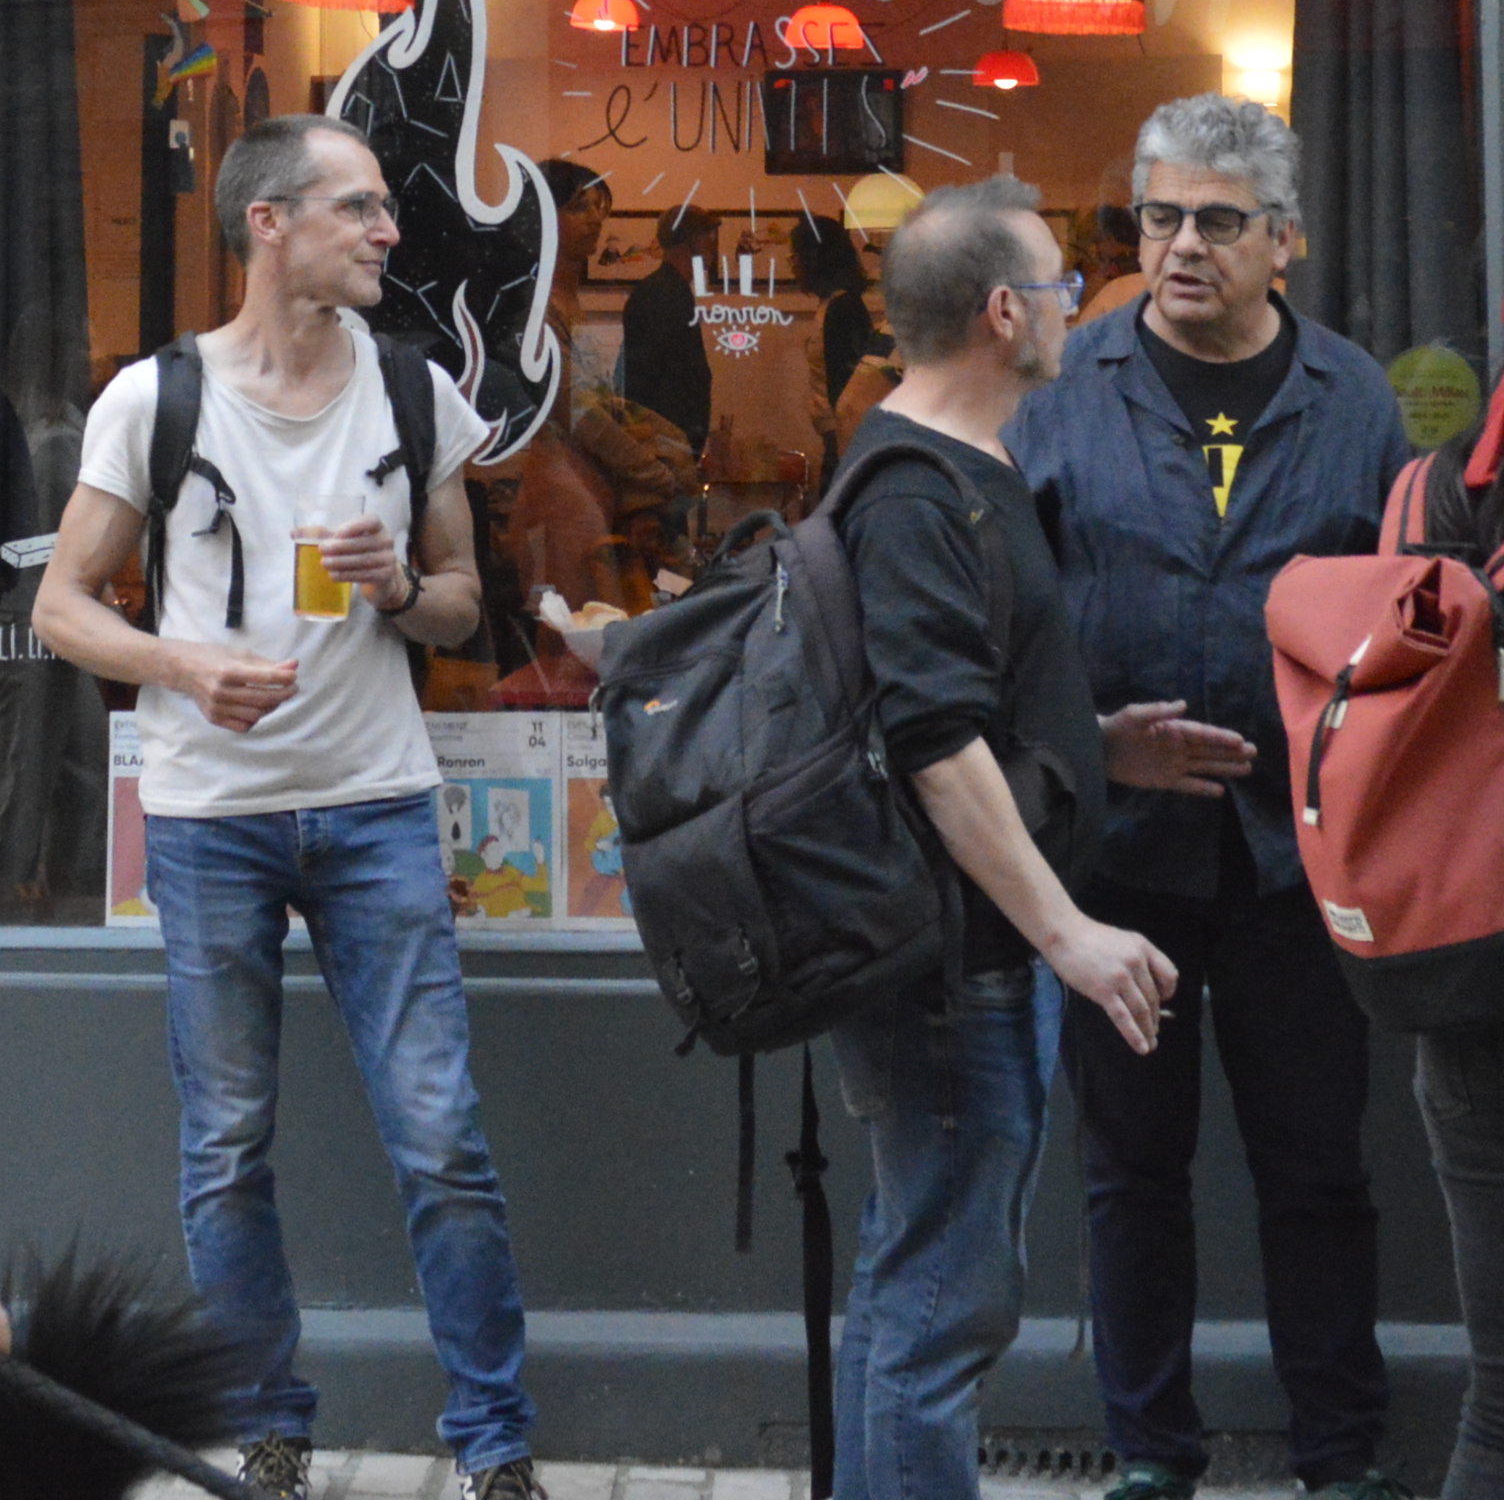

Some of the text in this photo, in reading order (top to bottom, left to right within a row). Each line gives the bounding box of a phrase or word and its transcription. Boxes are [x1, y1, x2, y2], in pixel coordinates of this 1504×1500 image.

[691, 253, 775, 299] LILI
[688, 304, 794, 327] ronron
[531, 722, 544, 733] 11
[529, 736, 546, 748] 04
[438, 756, 486, 768] Ronron
